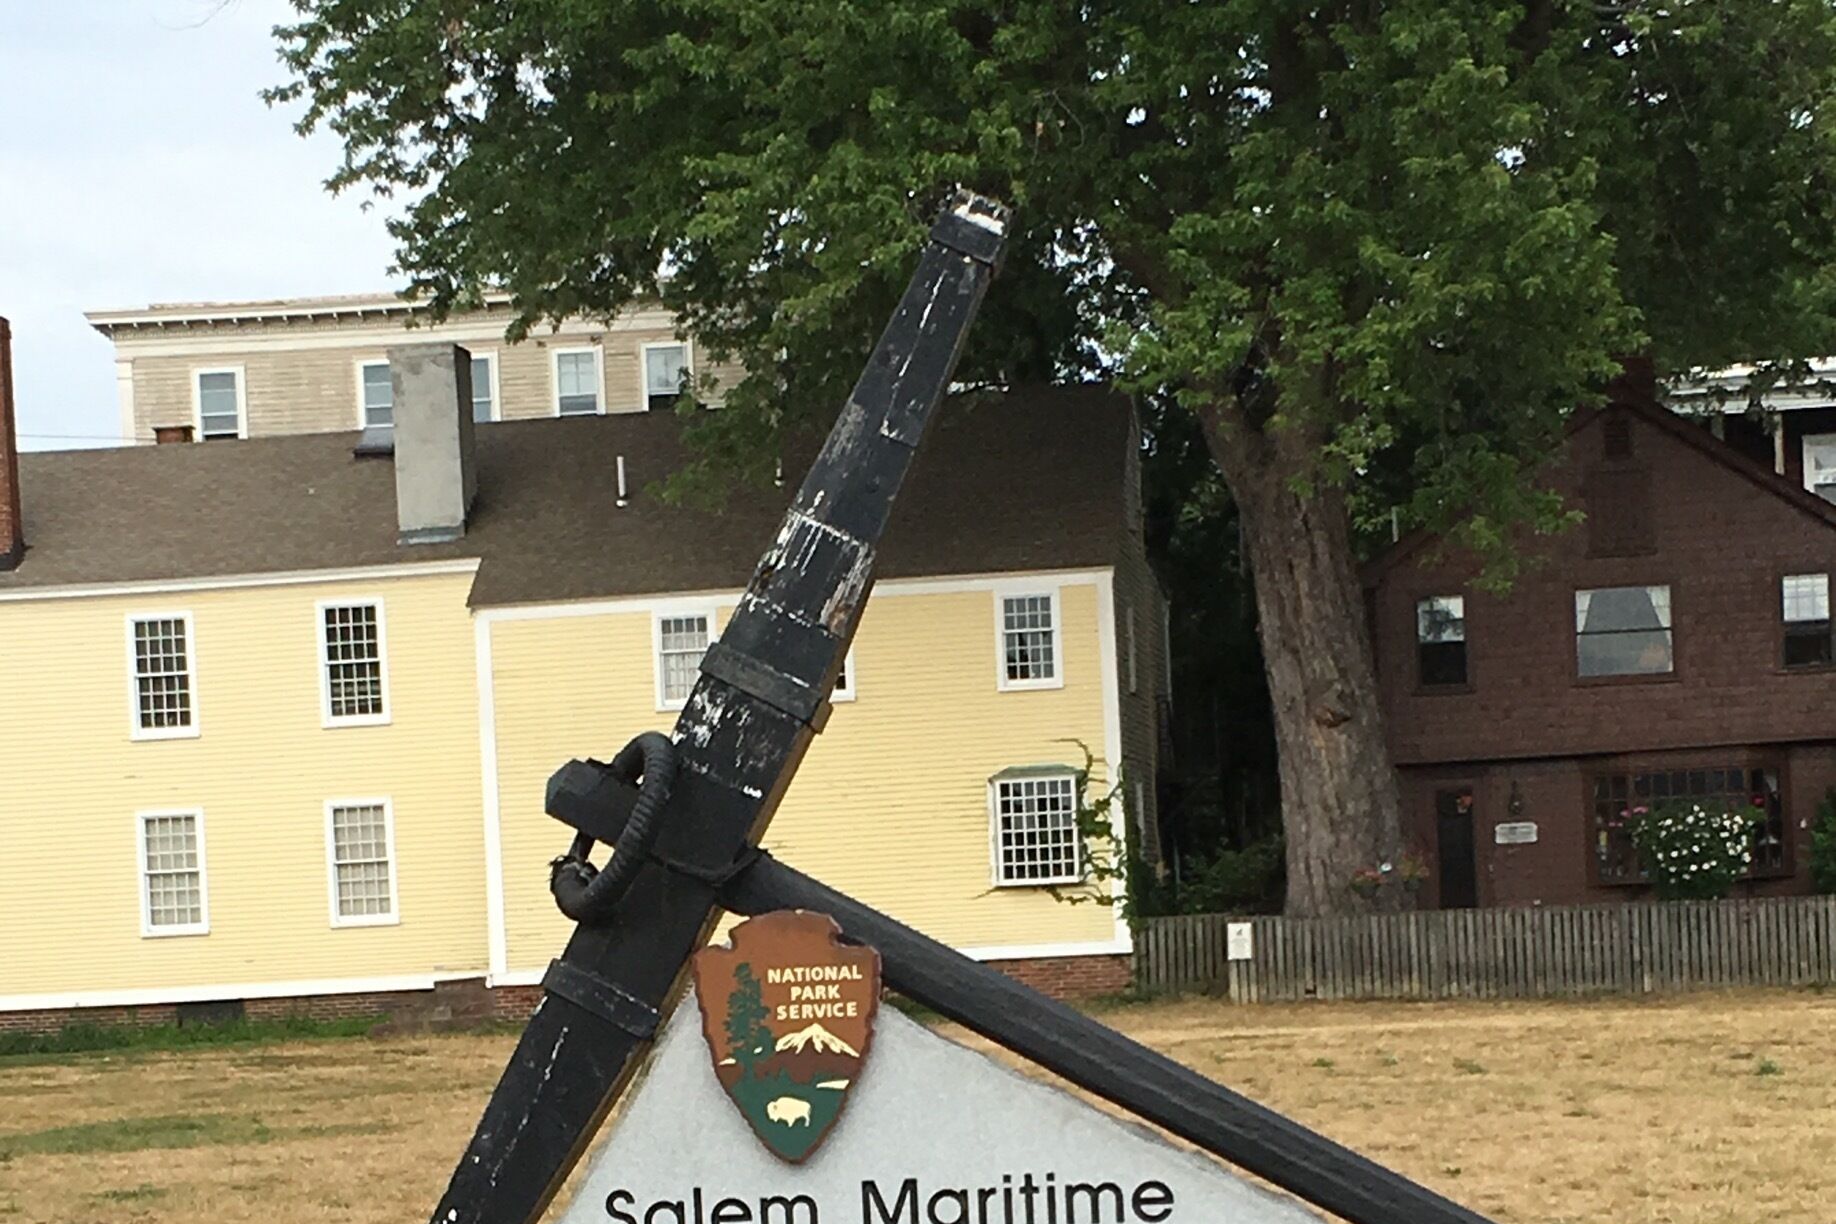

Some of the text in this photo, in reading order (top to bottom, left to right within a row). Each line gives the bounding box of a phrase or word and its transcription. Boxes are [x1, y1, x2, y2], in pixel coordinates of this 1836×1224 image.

[767, 965, 862, 984] NATIONAL
[790, 984, 841, 1002] PARK
[776, 1001, 858, 1021] SERVICE
